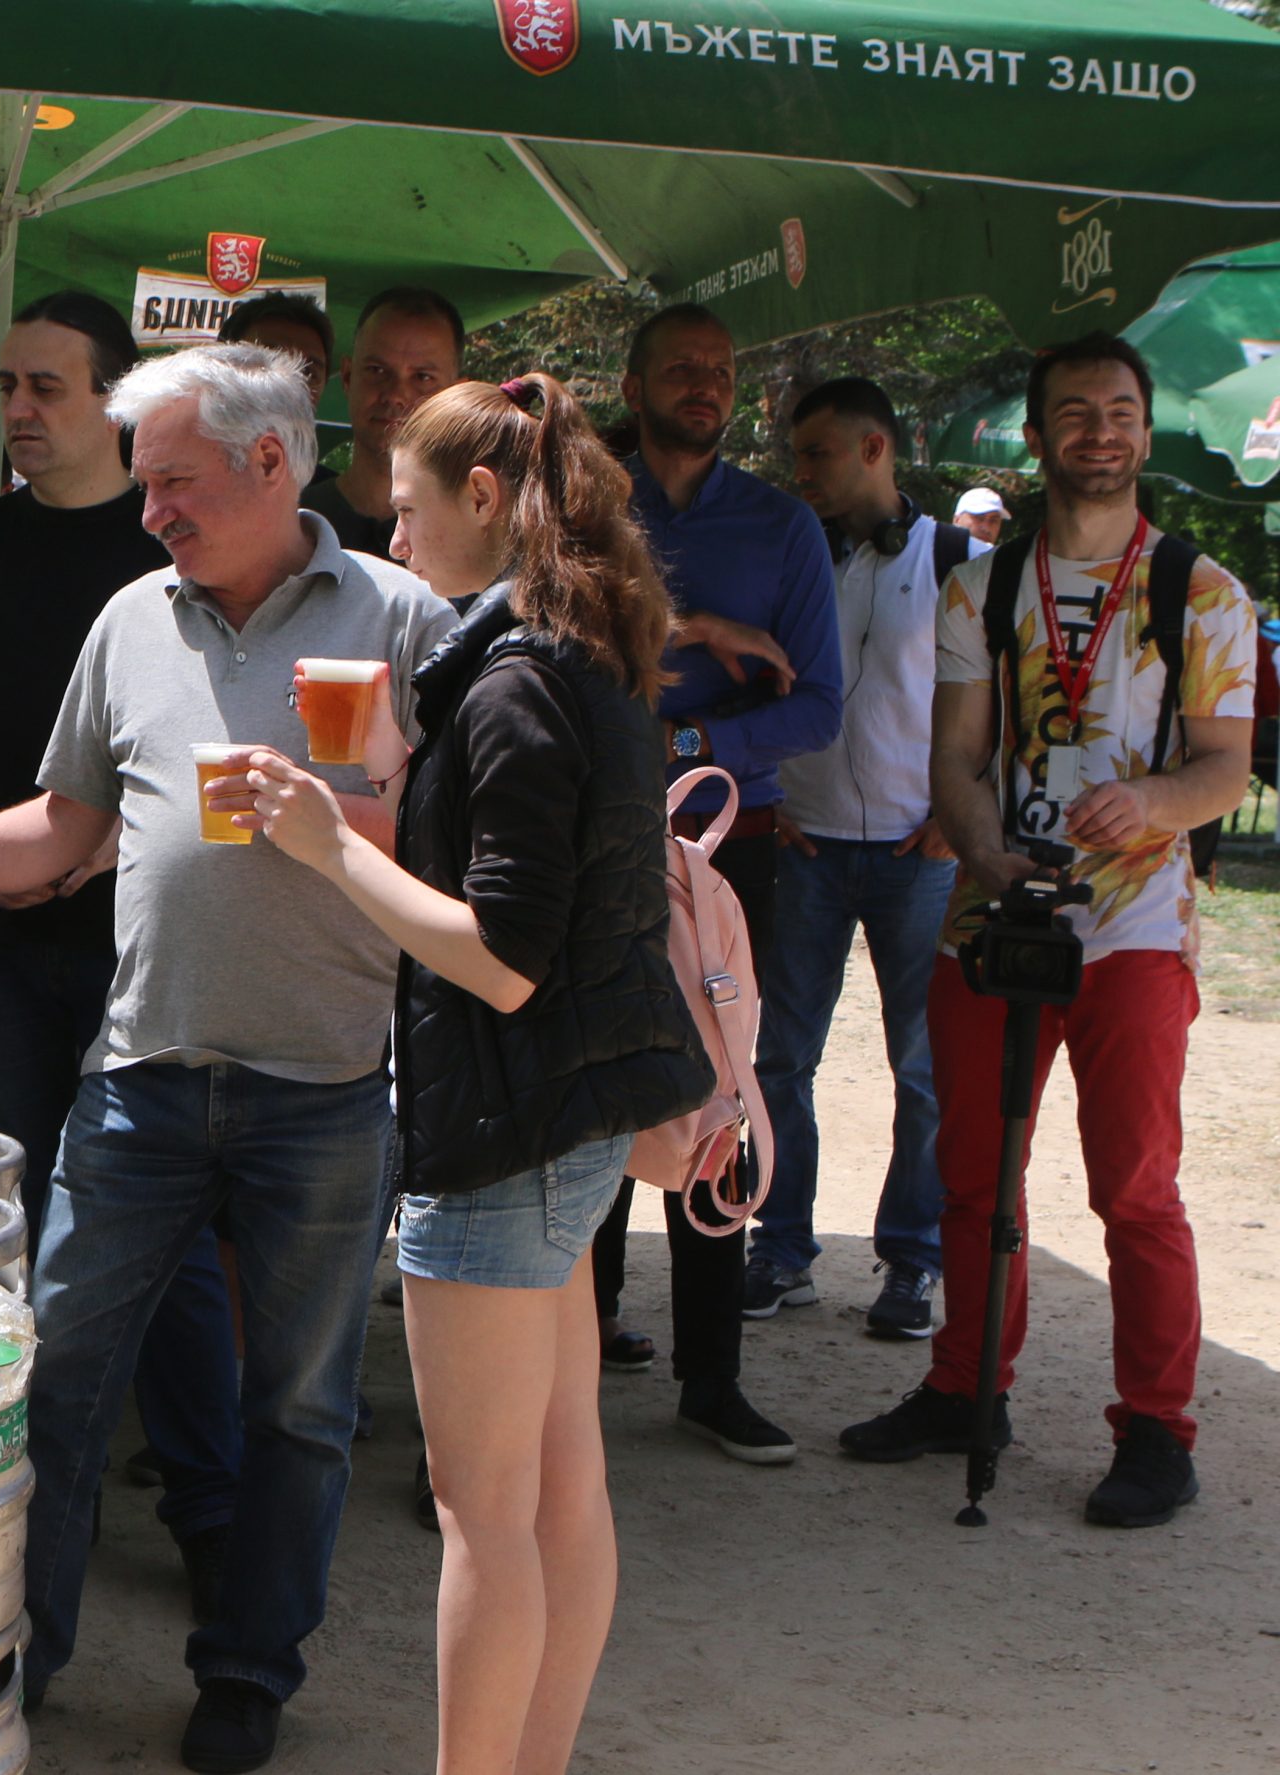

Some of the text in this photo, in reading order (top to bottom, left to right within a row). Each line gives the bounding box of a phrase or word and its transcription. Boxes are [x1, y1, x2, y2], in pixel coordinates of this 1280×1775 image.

[612, 18, 1197, 103] МЪЖЕТЕ ЗНАЯТ ЗАЩО
